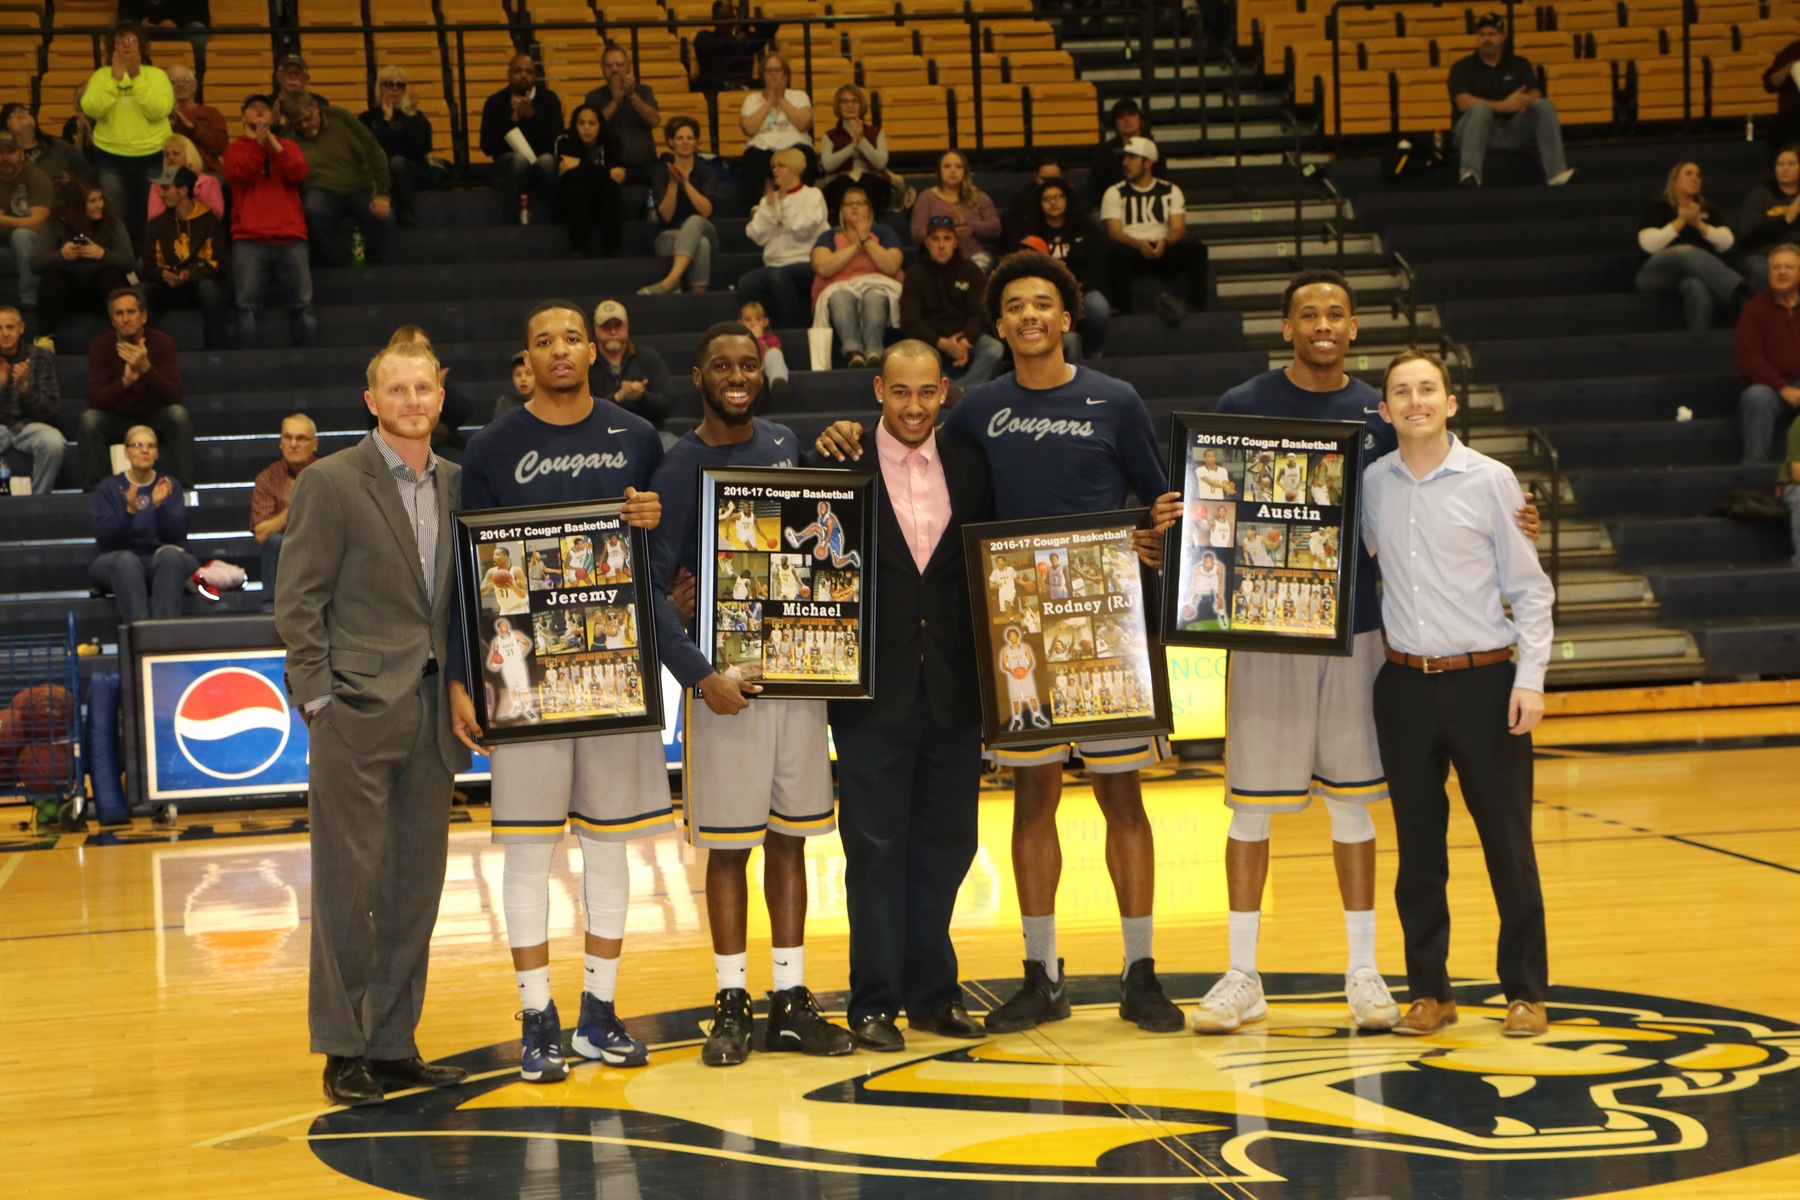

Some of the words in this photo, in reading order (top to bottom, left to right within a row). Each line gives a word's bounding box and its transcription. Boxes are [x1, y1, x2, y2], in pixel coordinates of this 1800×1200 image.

[987, 407, 1094, 441] Cougars
[1197, 434, 1239, 446] 2016-17
[1241, 436, 1280, 449] Cougar
[1281, 438, 1338, 451] Basketball
[514, 450, 628, 484] Cougars
[723, 486, 763, 497] 2016-17
[765, 488, 801, 500] Cougar
[803, 489, 854, 500] Basketball
[1257, 504, 1321, 521] Austin
[480, 527, 521, 540] 2016-17
[524, 525, 562, 539] Cougar
[564, 519, 620, 533] Basketball
[990, 539, 1031, 551] 2016-17
[1033, 535, 1070, 547] Cougar
[1072, 529, 1127, 543] Basketball
[546, 589, 618, 606] Jeremy
[783, 602, 841, 617] Michael
[1042, 599, 1102, 615] Rodney
